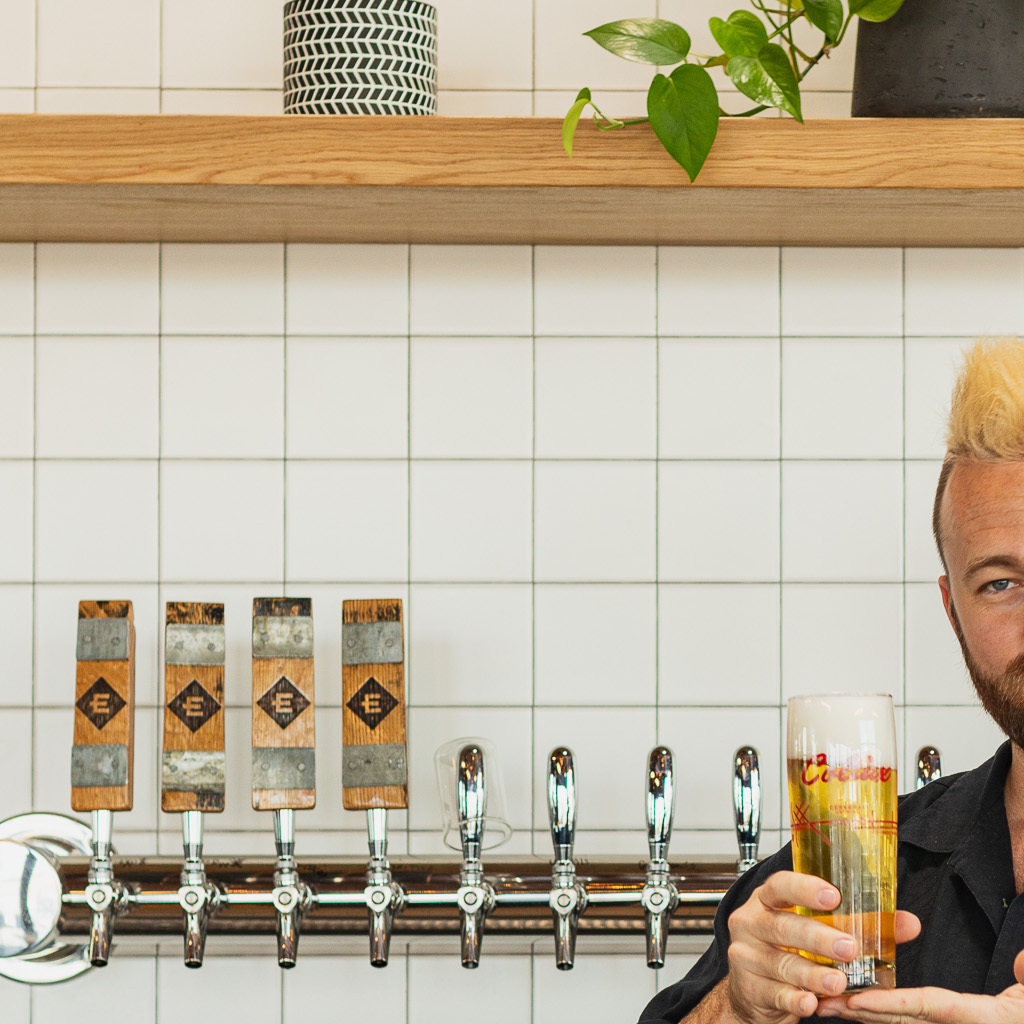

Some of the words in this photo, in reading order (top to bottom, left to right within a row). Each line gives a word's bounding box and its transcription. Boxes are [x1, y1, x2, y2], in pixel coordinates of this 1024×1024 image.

[89, 693, 110, 714] E
[182, 696, 204, 717] E
[271, 692, 293, 713] E
[361, 693, 382, 714] E
